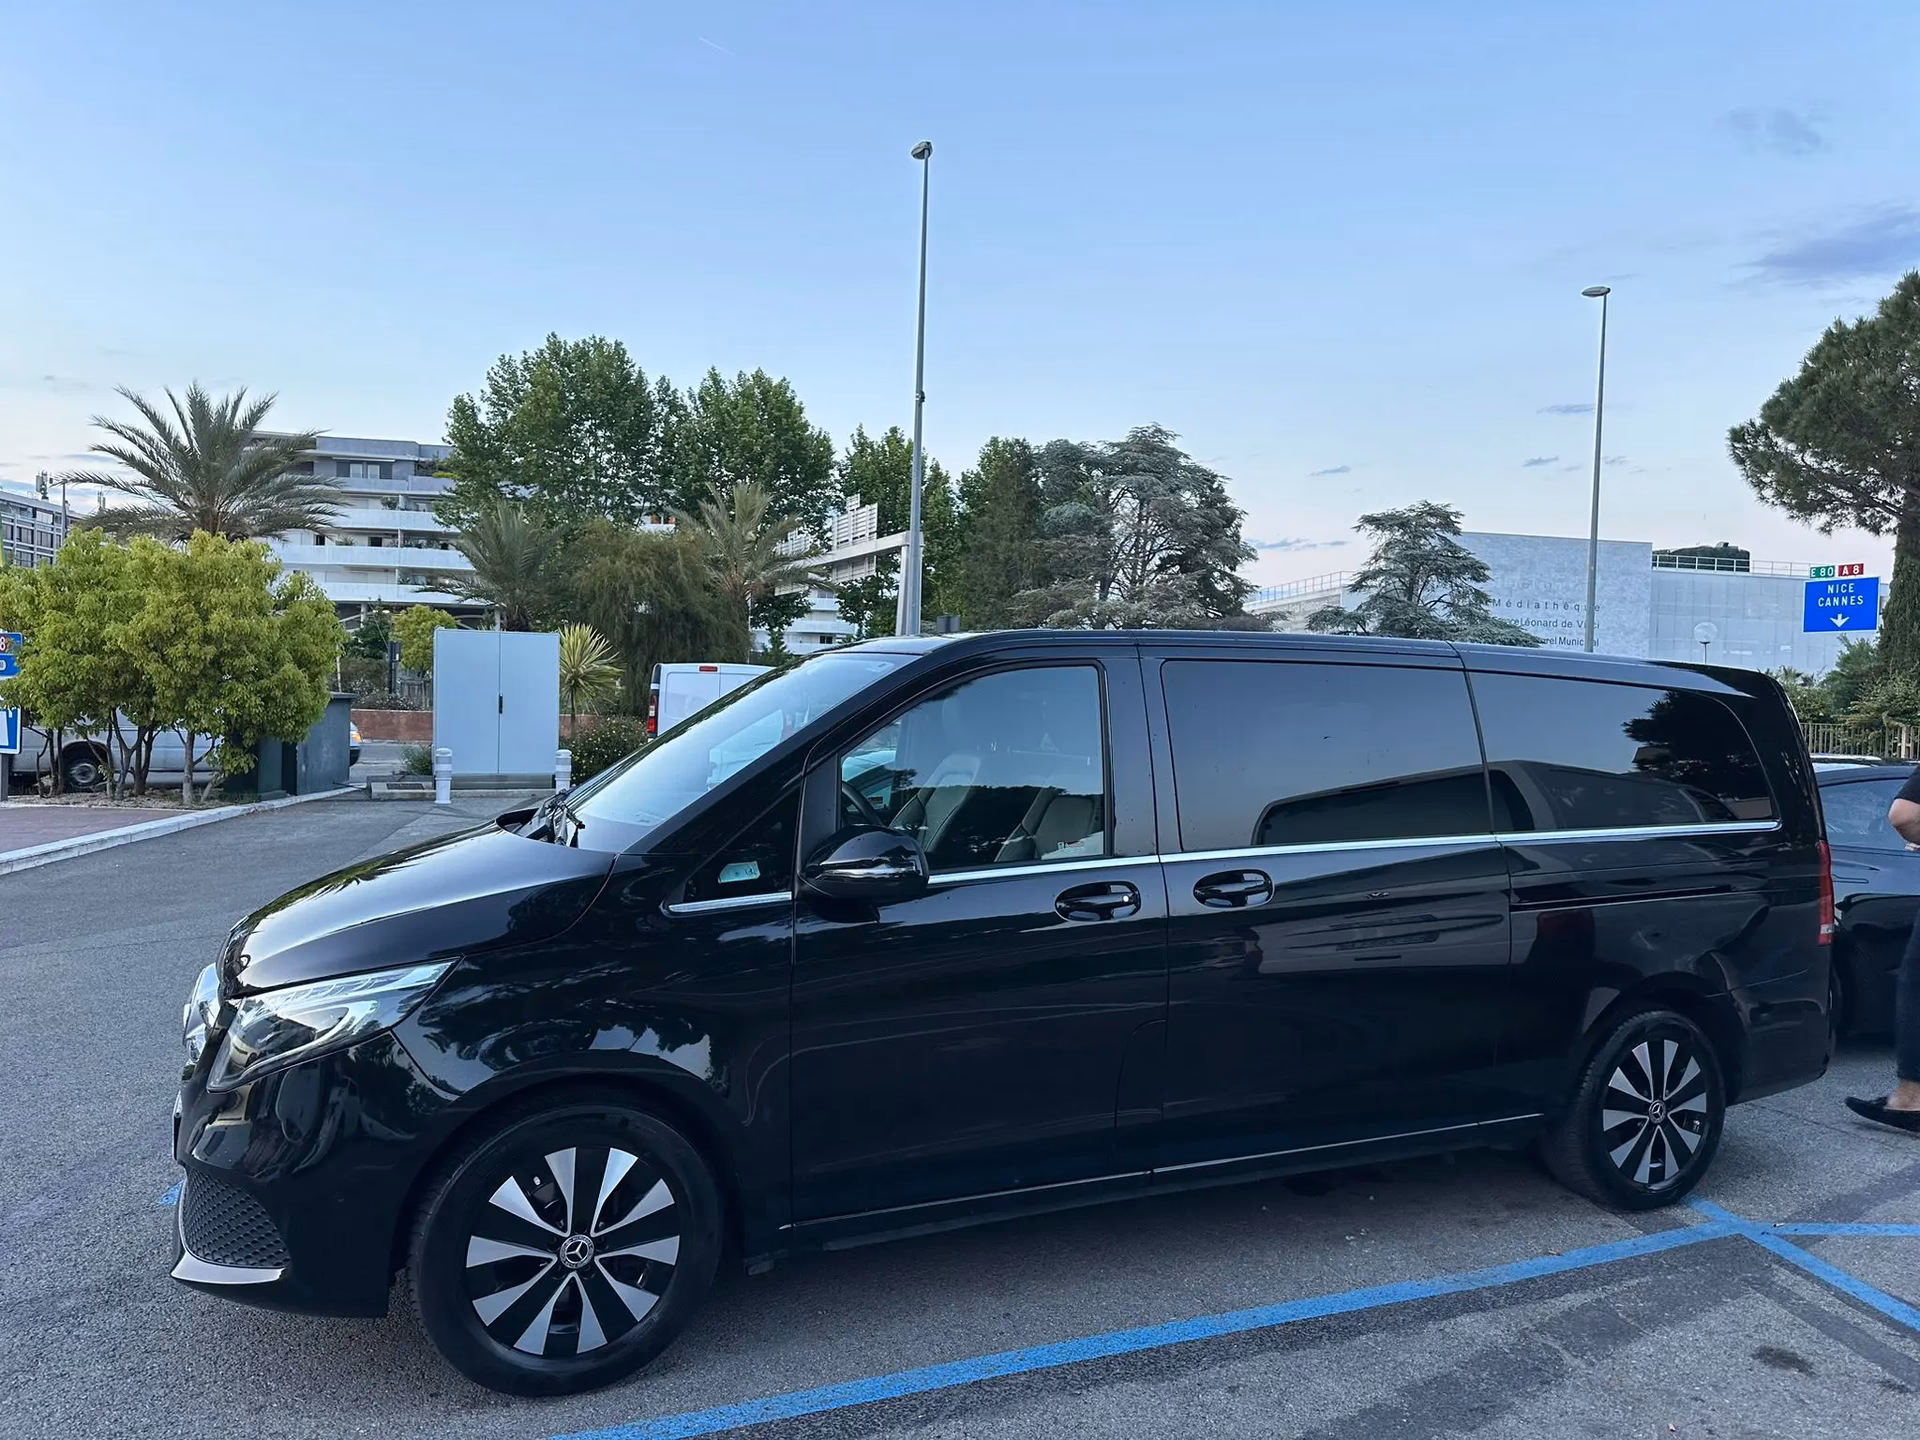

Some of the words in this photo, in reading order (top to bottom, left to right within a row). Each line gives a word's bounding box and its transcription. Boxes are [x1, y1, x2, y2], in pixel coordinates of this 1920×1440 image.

[1827, 583, 1855, 594] NICE
[1818, 595, 1864, 607] CANNES
[1520, 617, 1558, 628] Léonard
[1561, 620, 1573, 629] de
[1576, 619, 1600, 630] Vici
[1558, 636, 1600, 647] Munical
